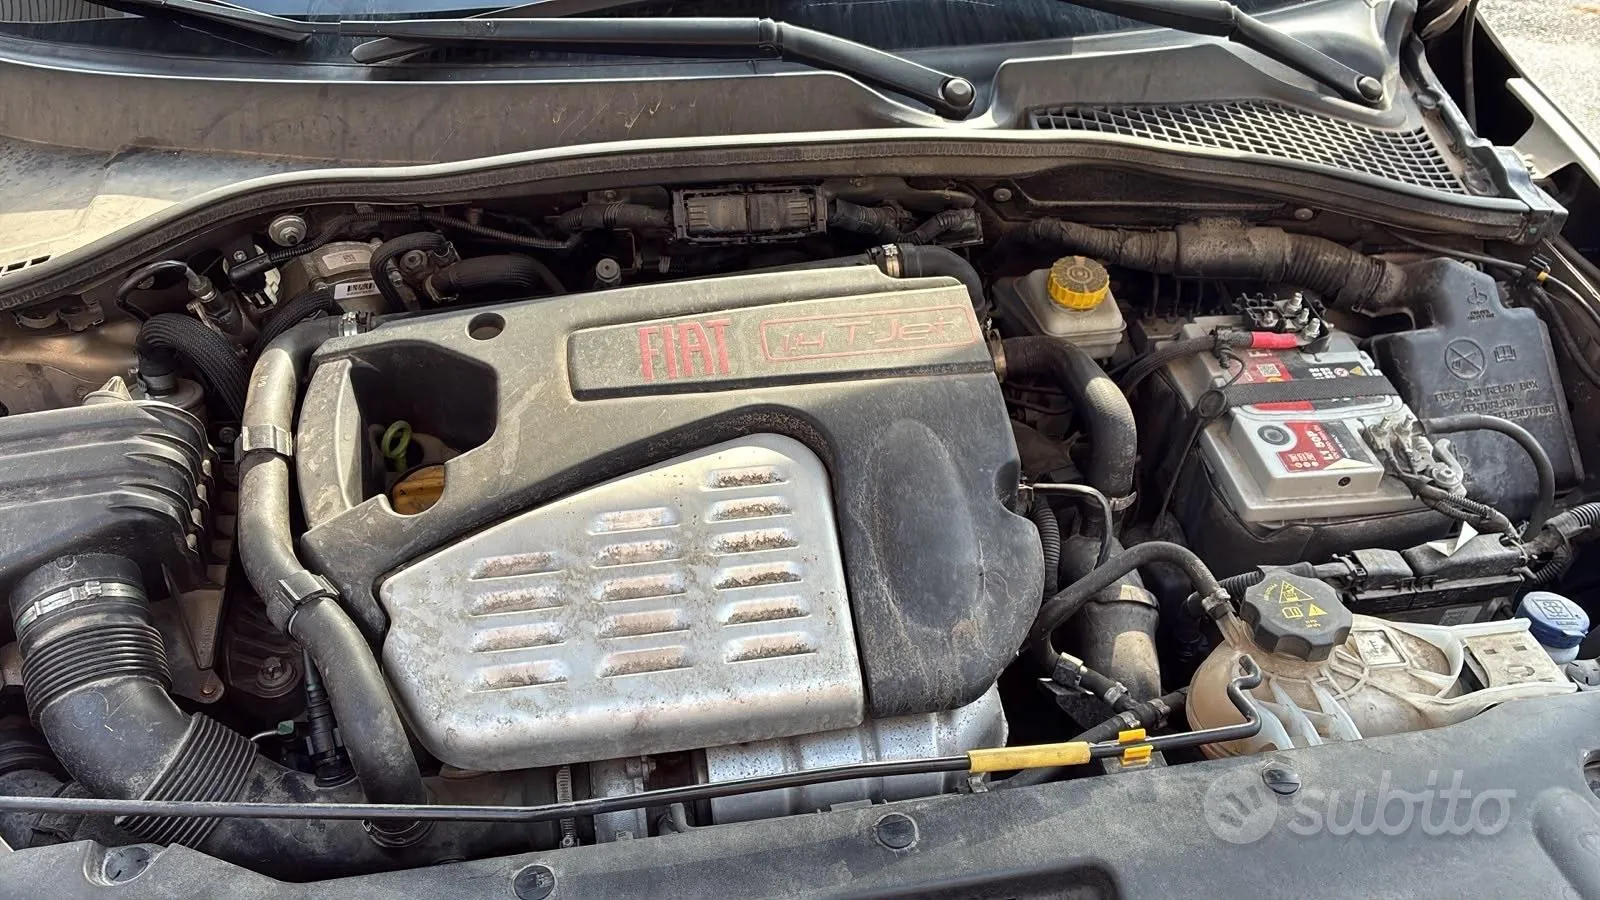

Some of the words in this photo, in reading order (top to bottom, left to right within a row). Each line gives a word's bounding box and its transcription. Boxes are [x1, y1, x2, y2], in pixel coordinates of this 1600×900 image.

[638, 318, 731, 383] FIAT
[782, 331, 826, 352] 1.4
[835, 315, 962, 346] T-Jet
[1434, 391, 1460, 402] FUSE
[1464, 387, 1482, 398] AND
[1486, 383, 1516, 395] RELAY
[1519, 380, 1539, 391] BOX
